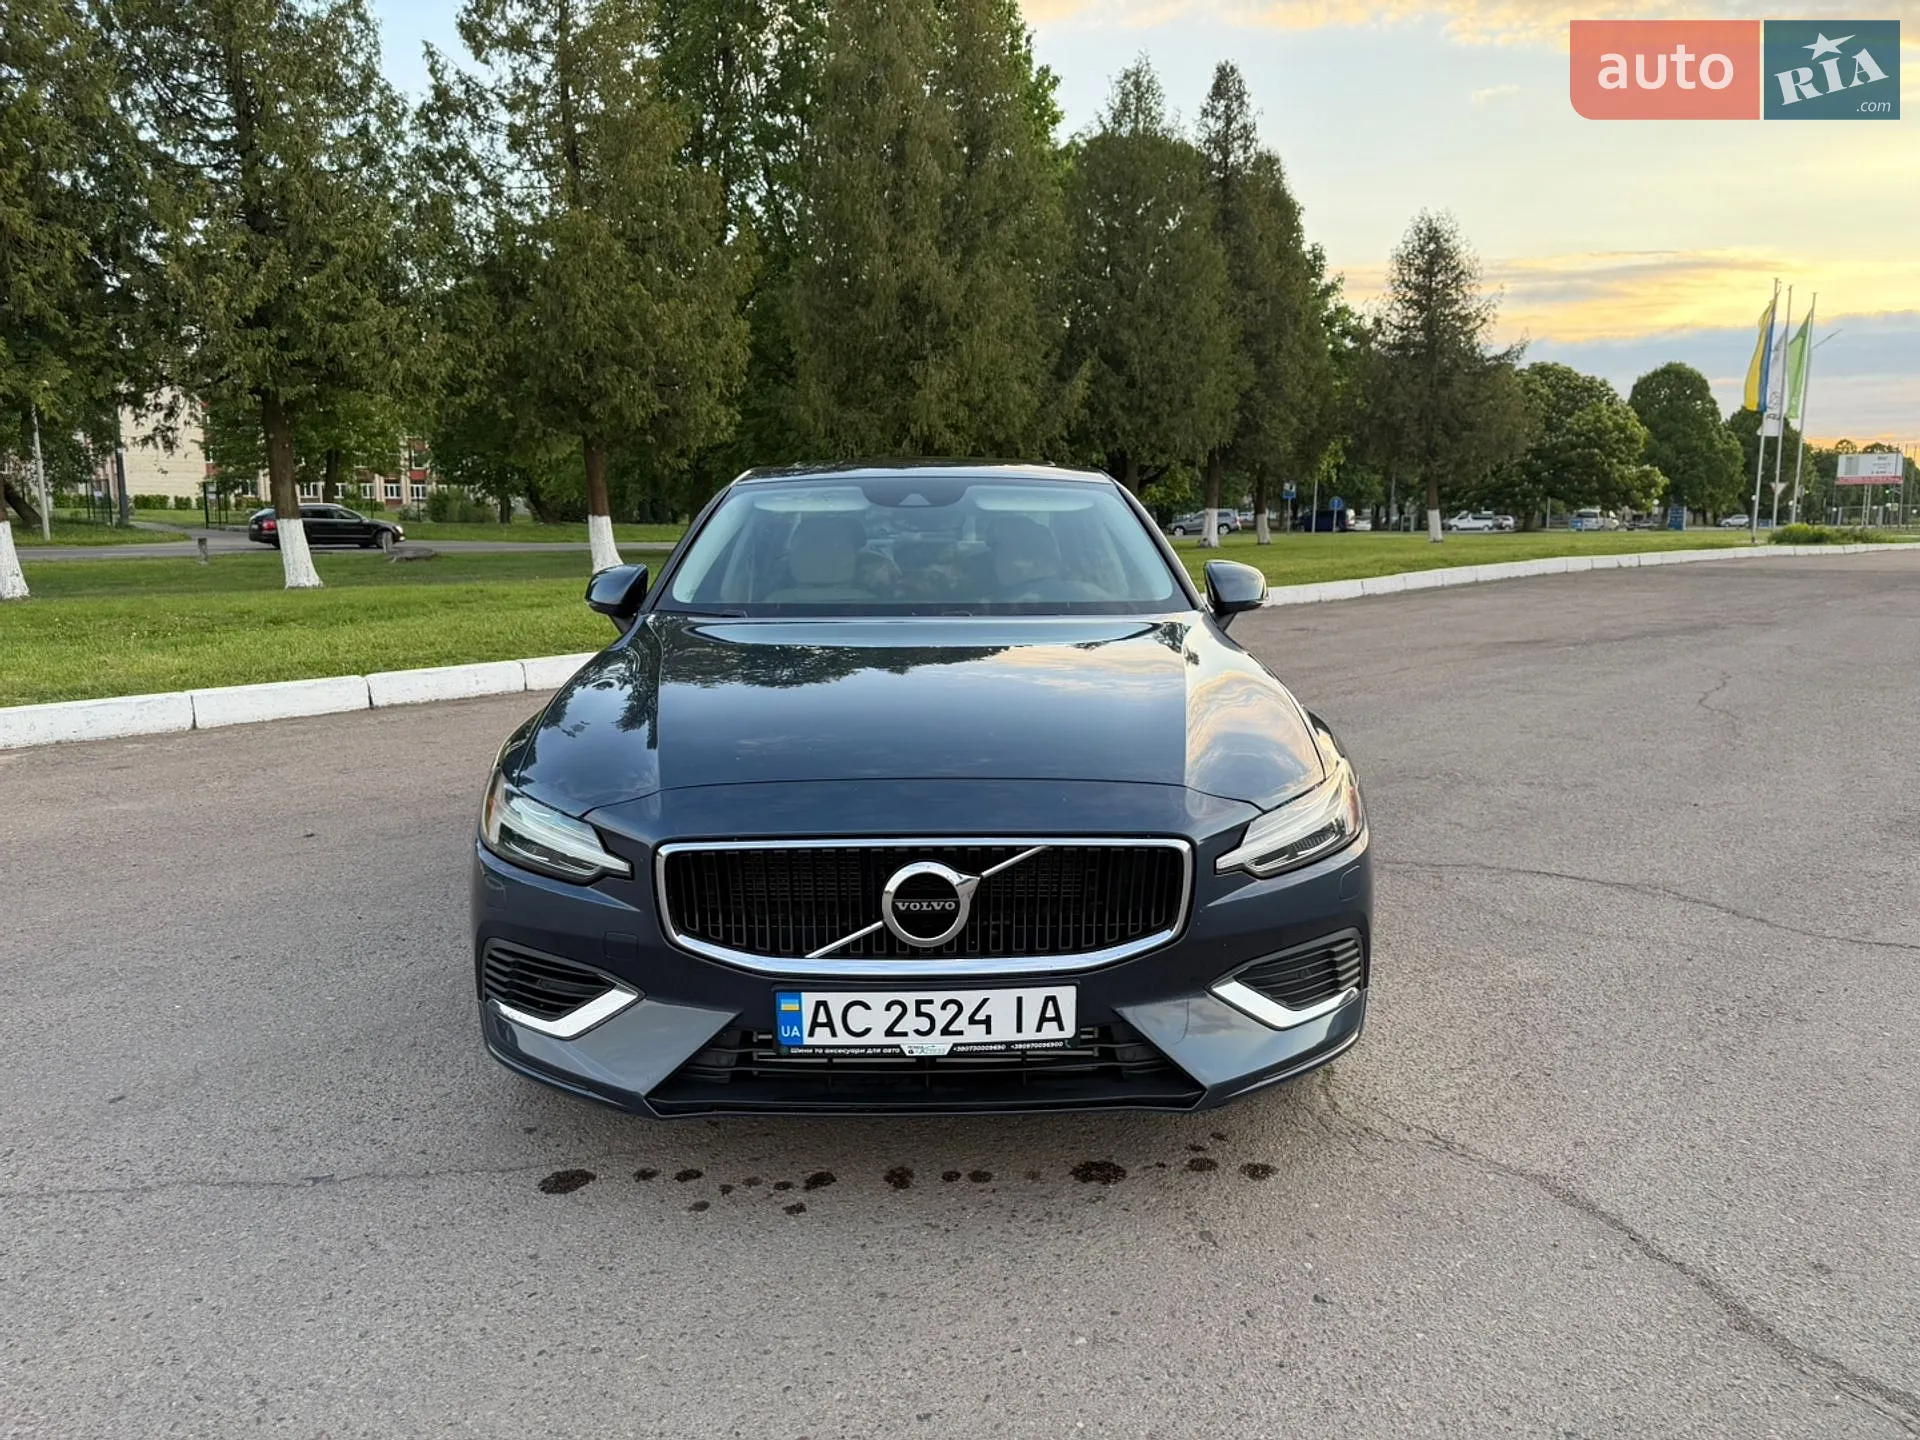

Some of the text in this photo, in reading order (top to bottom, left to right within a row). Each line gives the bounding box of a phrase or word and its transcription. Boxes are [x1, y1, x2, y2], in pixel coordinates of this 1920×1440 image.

[895, 901, 956, 911] VOLVO
[807, 994, 1065, 1038] AC 2524 IA
[781, 1025, 801, 1037] UA
